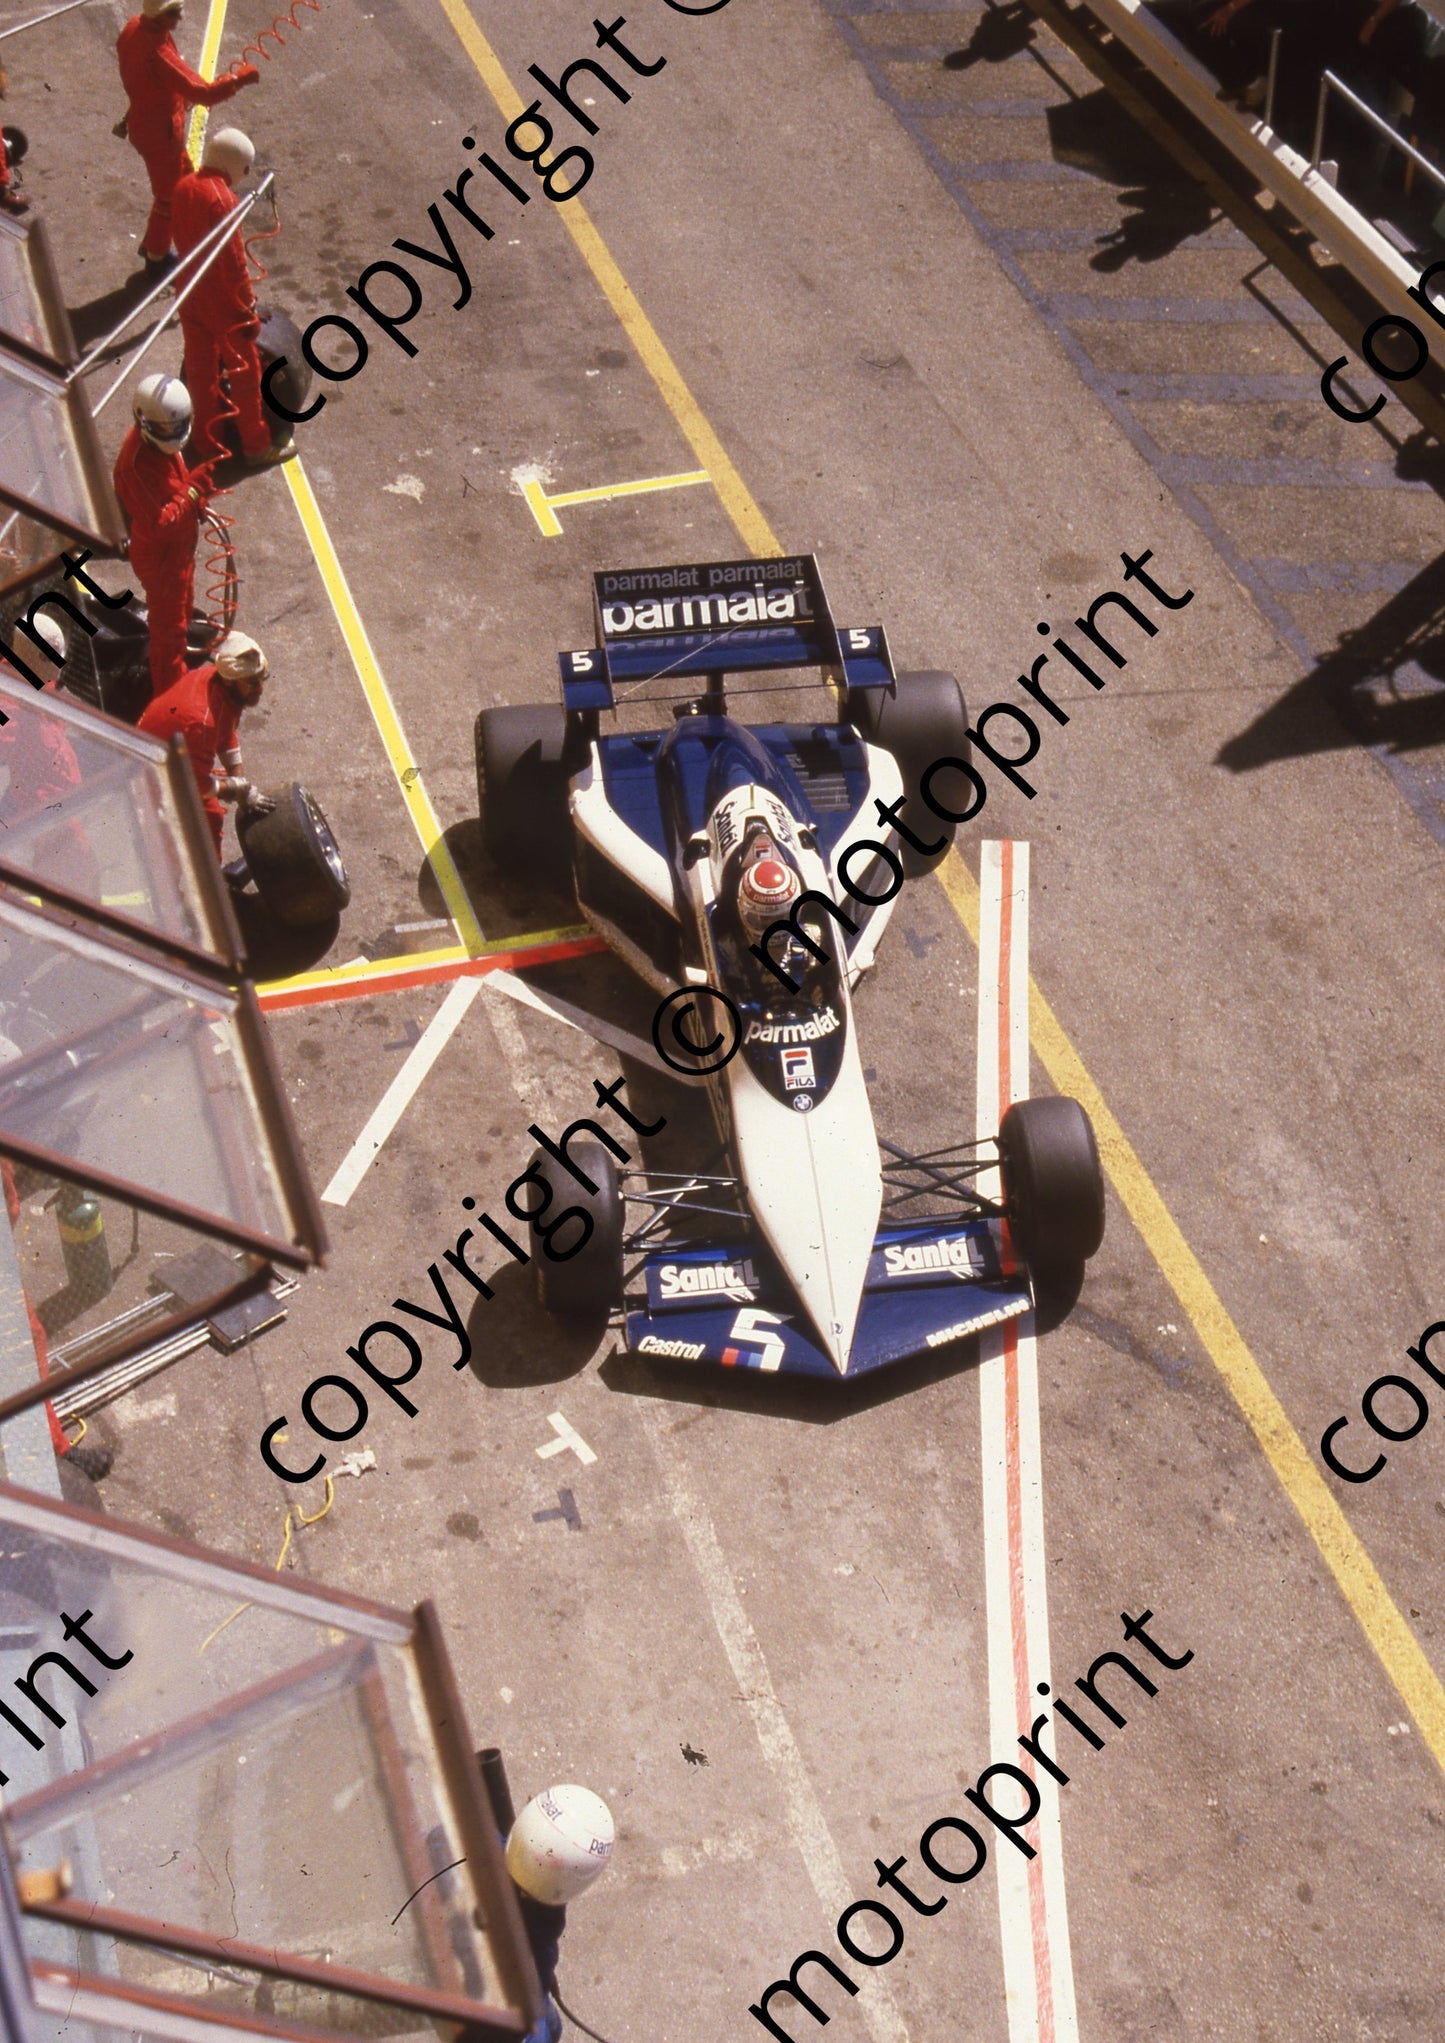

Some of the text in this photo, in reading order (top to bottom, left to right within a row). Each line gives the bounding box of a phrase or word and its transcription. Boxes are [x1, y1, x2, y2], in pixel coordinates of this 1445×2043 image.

[604, 562, 804, 595] parmalat parmalat
[602, 580, 814, 633] parmalat
[849, 628, 871, 650] 5
[571, 652, 593, 672] 5
[744, 1006, 840, 1044] parmalat
[786, 1078, 814, 1089] FILA
[926, 1298, 1030, 1348] MICHELIN
[638, 1335, 706, 1360] Castrol
[730, 1309, 785, 1371] 5
